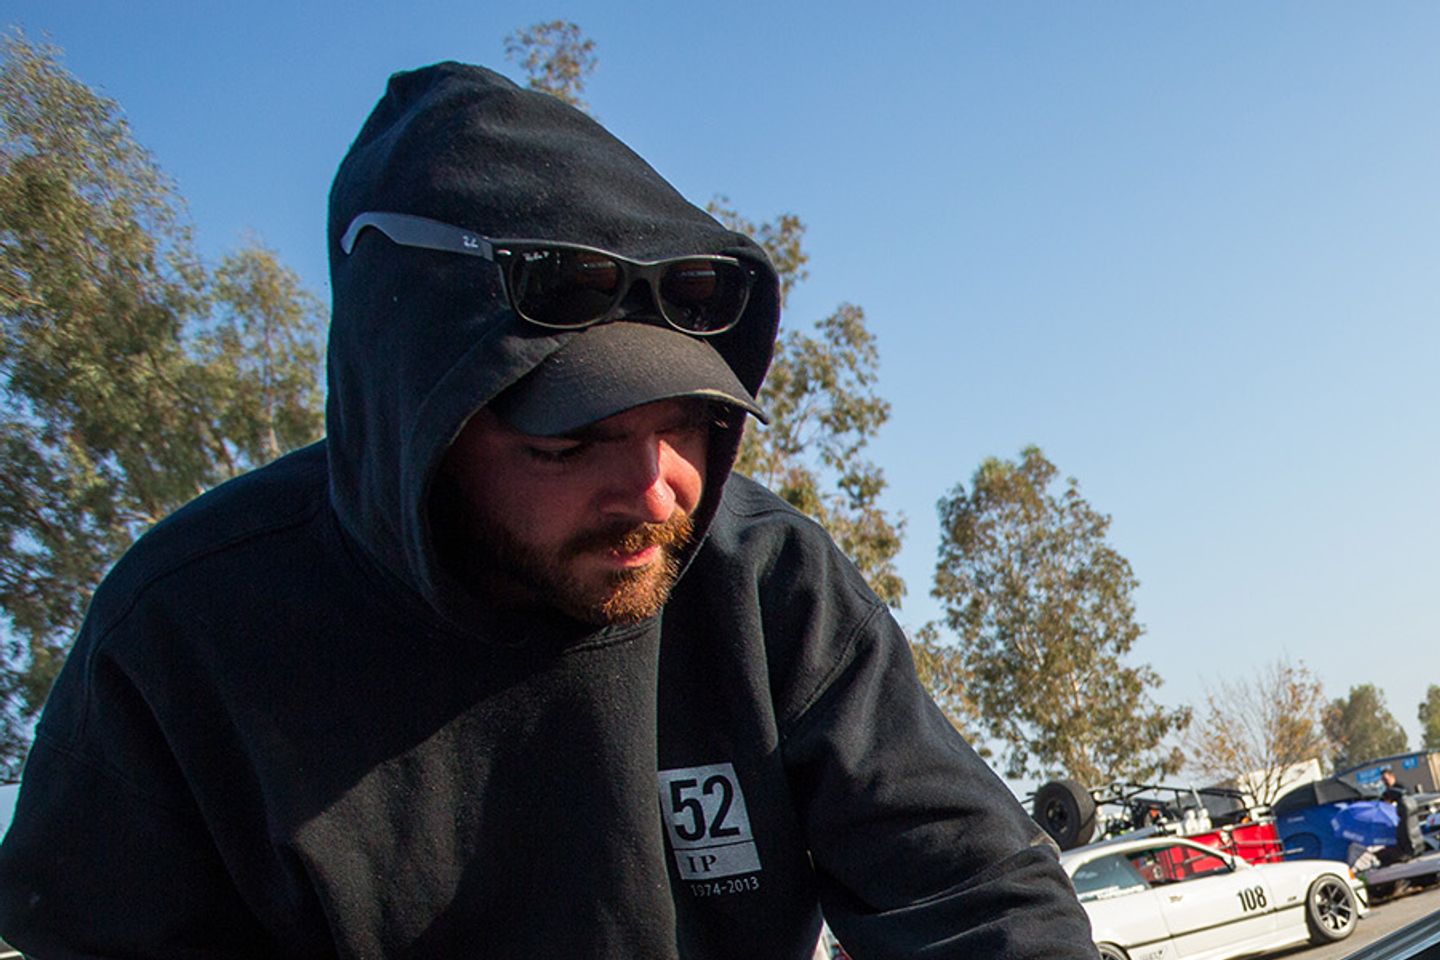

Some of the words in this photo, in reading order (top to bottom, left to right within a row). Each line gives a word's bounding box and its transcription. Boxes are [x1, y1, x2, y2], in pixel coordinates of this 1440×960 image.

[669, 774, 741, 842] 52
[690, 876, 760, 897] 1974-2013
[1236, 885, 1267, 912] 108
